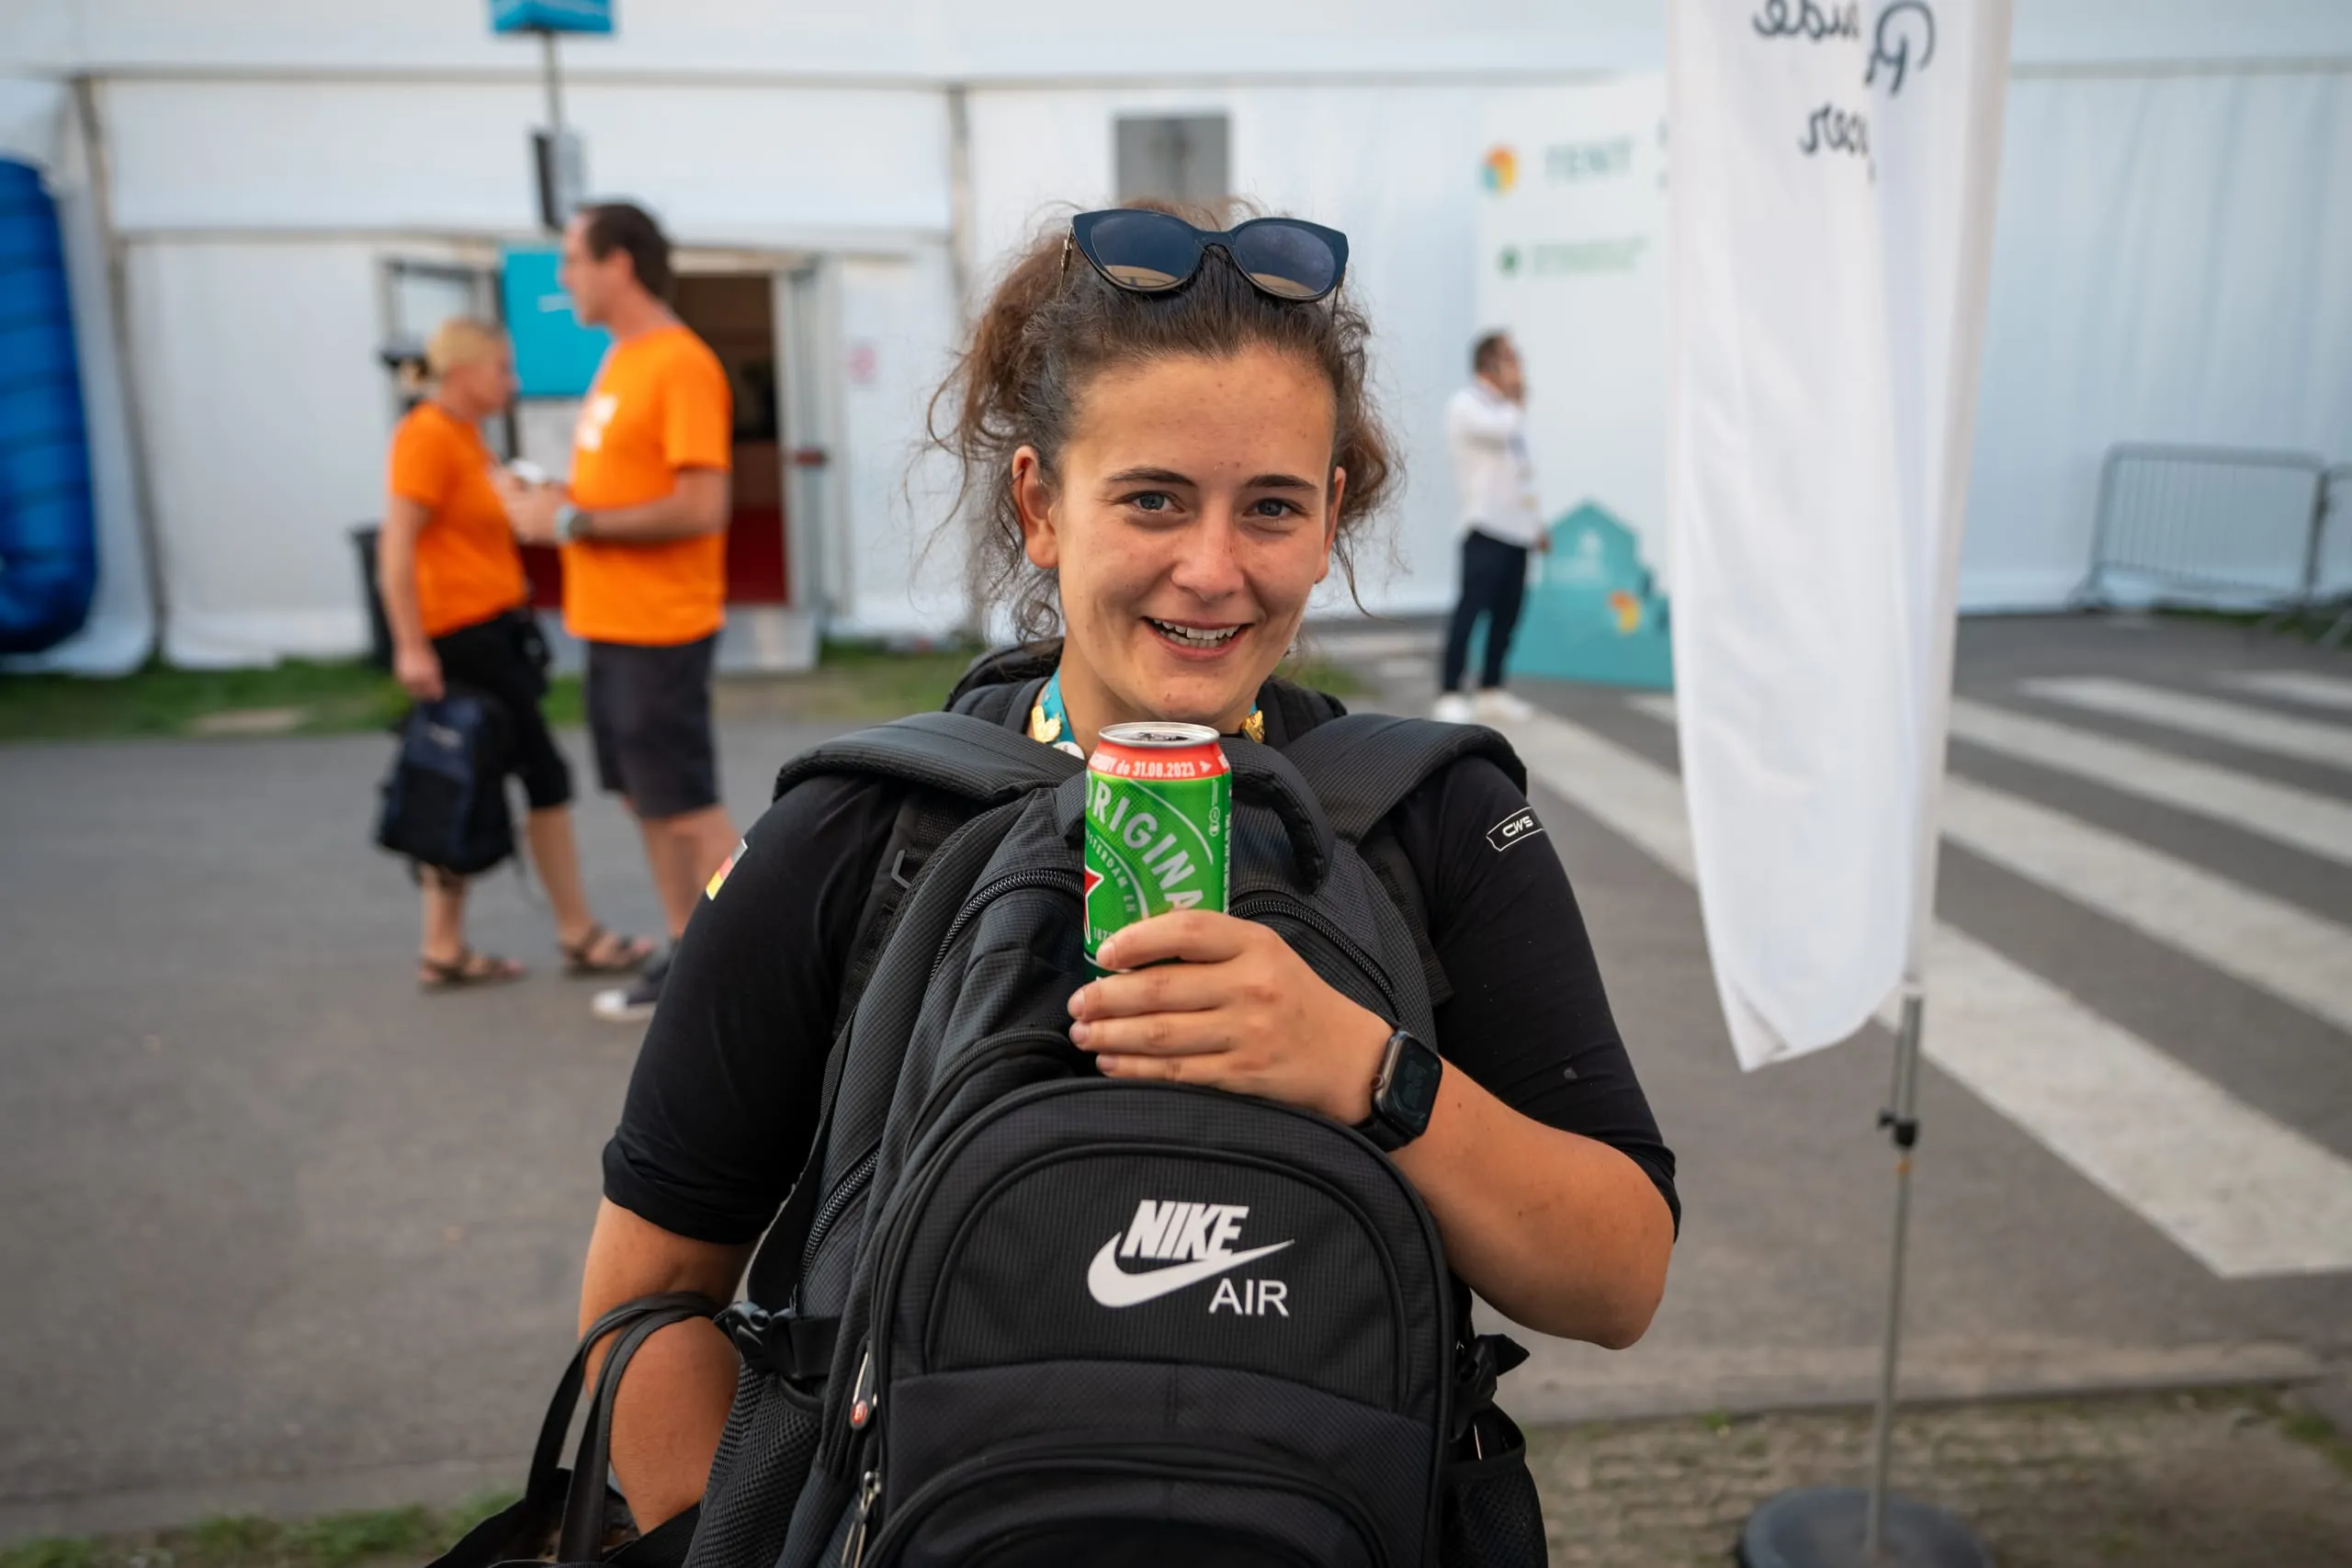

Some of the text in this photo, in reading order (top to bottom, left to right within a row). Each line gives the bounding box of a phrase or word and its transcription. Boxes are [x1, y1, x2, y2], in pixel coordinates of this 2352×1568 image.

[1116, 760, 1130, 775] do
[1132, 761, 1195, 778] 31.08.2023
[1502, 815, 1533, 838] CWS
[1120, 1199, 1250, 1259] NIKE
[1208, 1278, 1289, 1316] AIR
